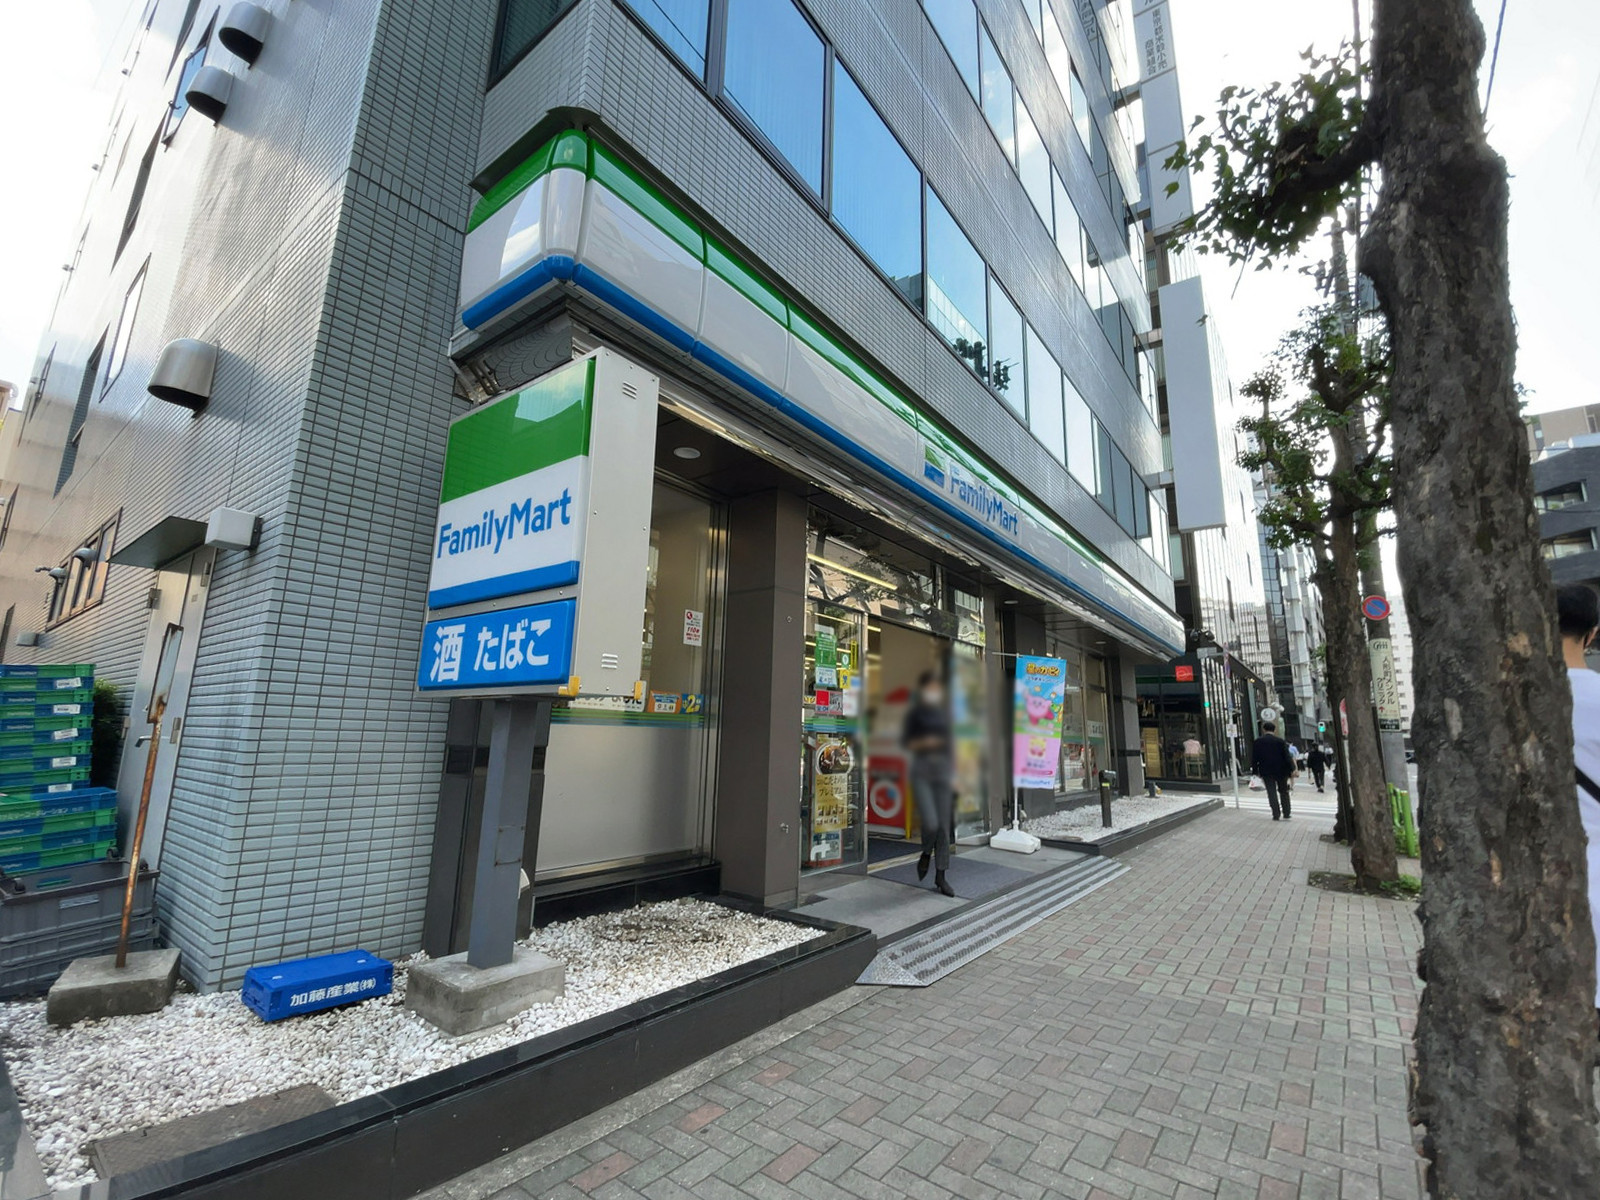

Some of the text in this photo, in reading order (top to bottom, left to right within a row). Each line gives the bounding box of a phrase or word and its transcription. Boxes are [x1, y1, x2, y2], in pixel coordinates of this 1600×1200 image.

[437, 488, 571, 558] FamilyMart
[950, 465, 1018, 535] FamilyMart
[430, 618, 551, 682] 酒 たばこ
[290, 977, 377, 1007] 加藤産業(株)
